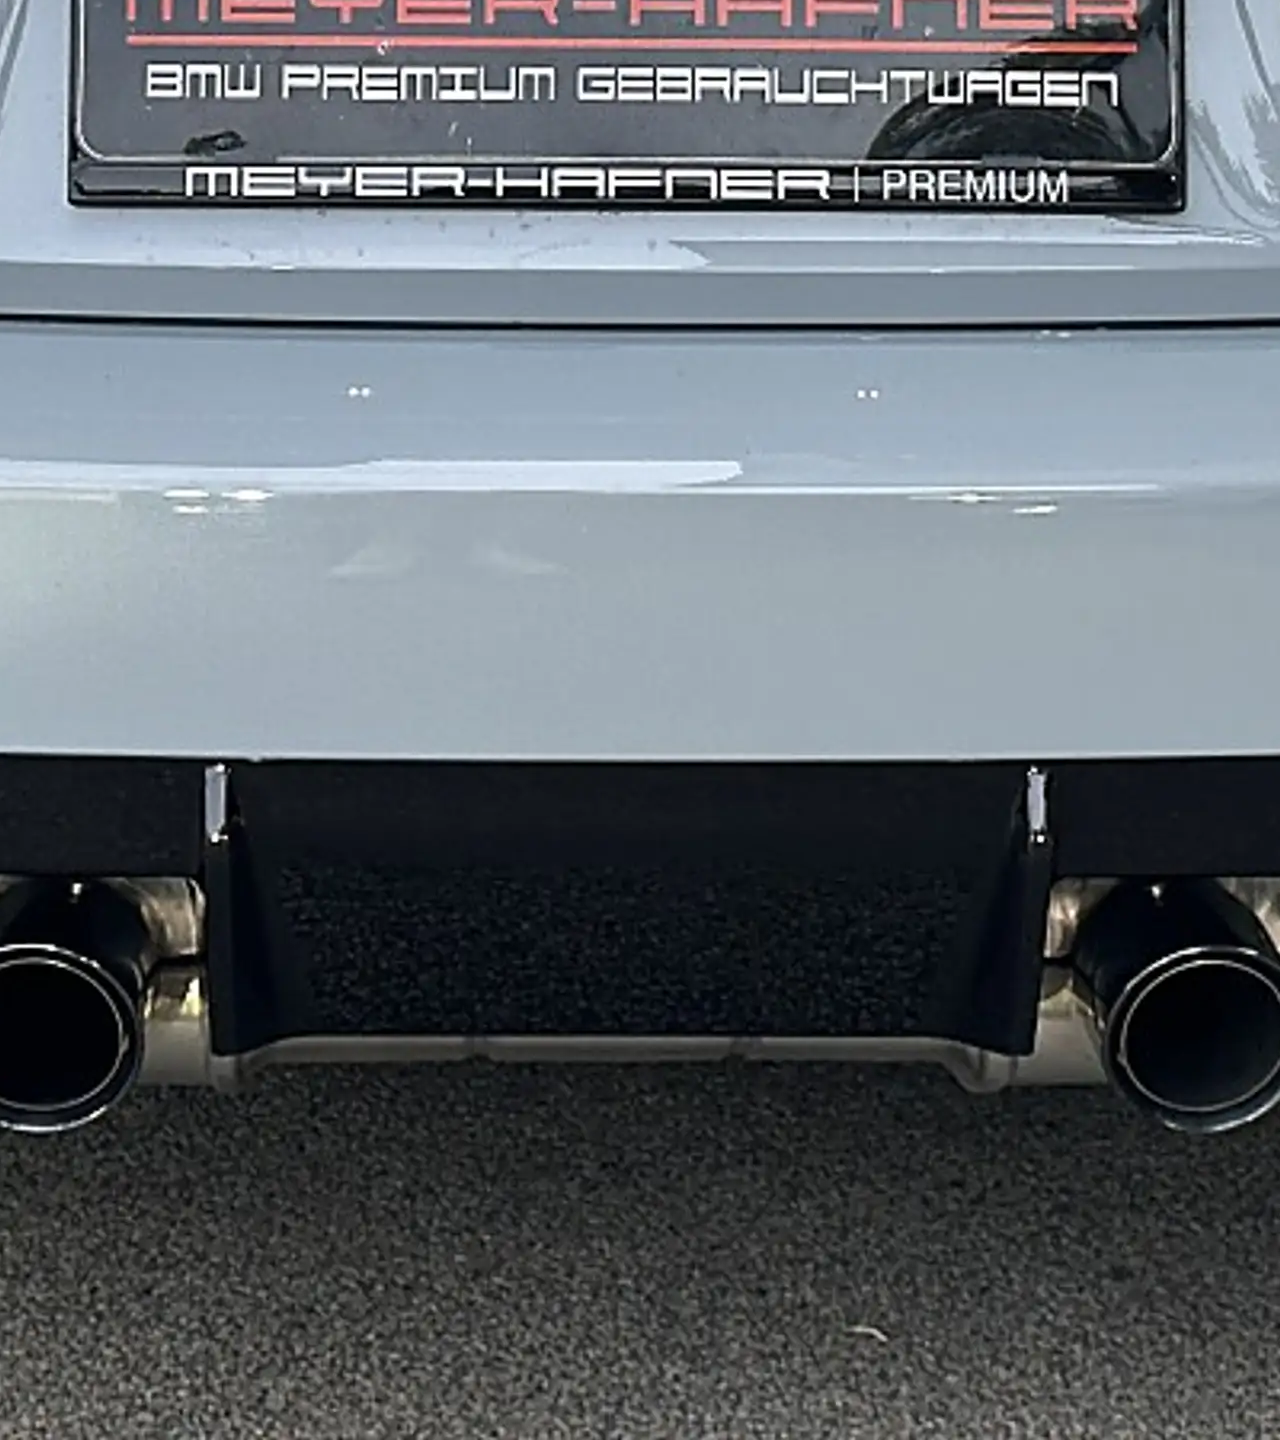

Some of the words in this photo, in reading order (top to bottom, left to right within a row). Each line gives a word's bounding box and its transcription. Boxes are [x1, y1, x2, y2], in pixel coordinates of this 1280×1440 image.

[146, 63, 262, 99] BMW
[281, 64, 556, 102] PREMIUM
[577, 66, 1119, 108] GEBRAUCHTWAGEN
[184, 165, 831, 201] MEYER-HAFNER
[882, 169, 1069, 203] PREMIUM
